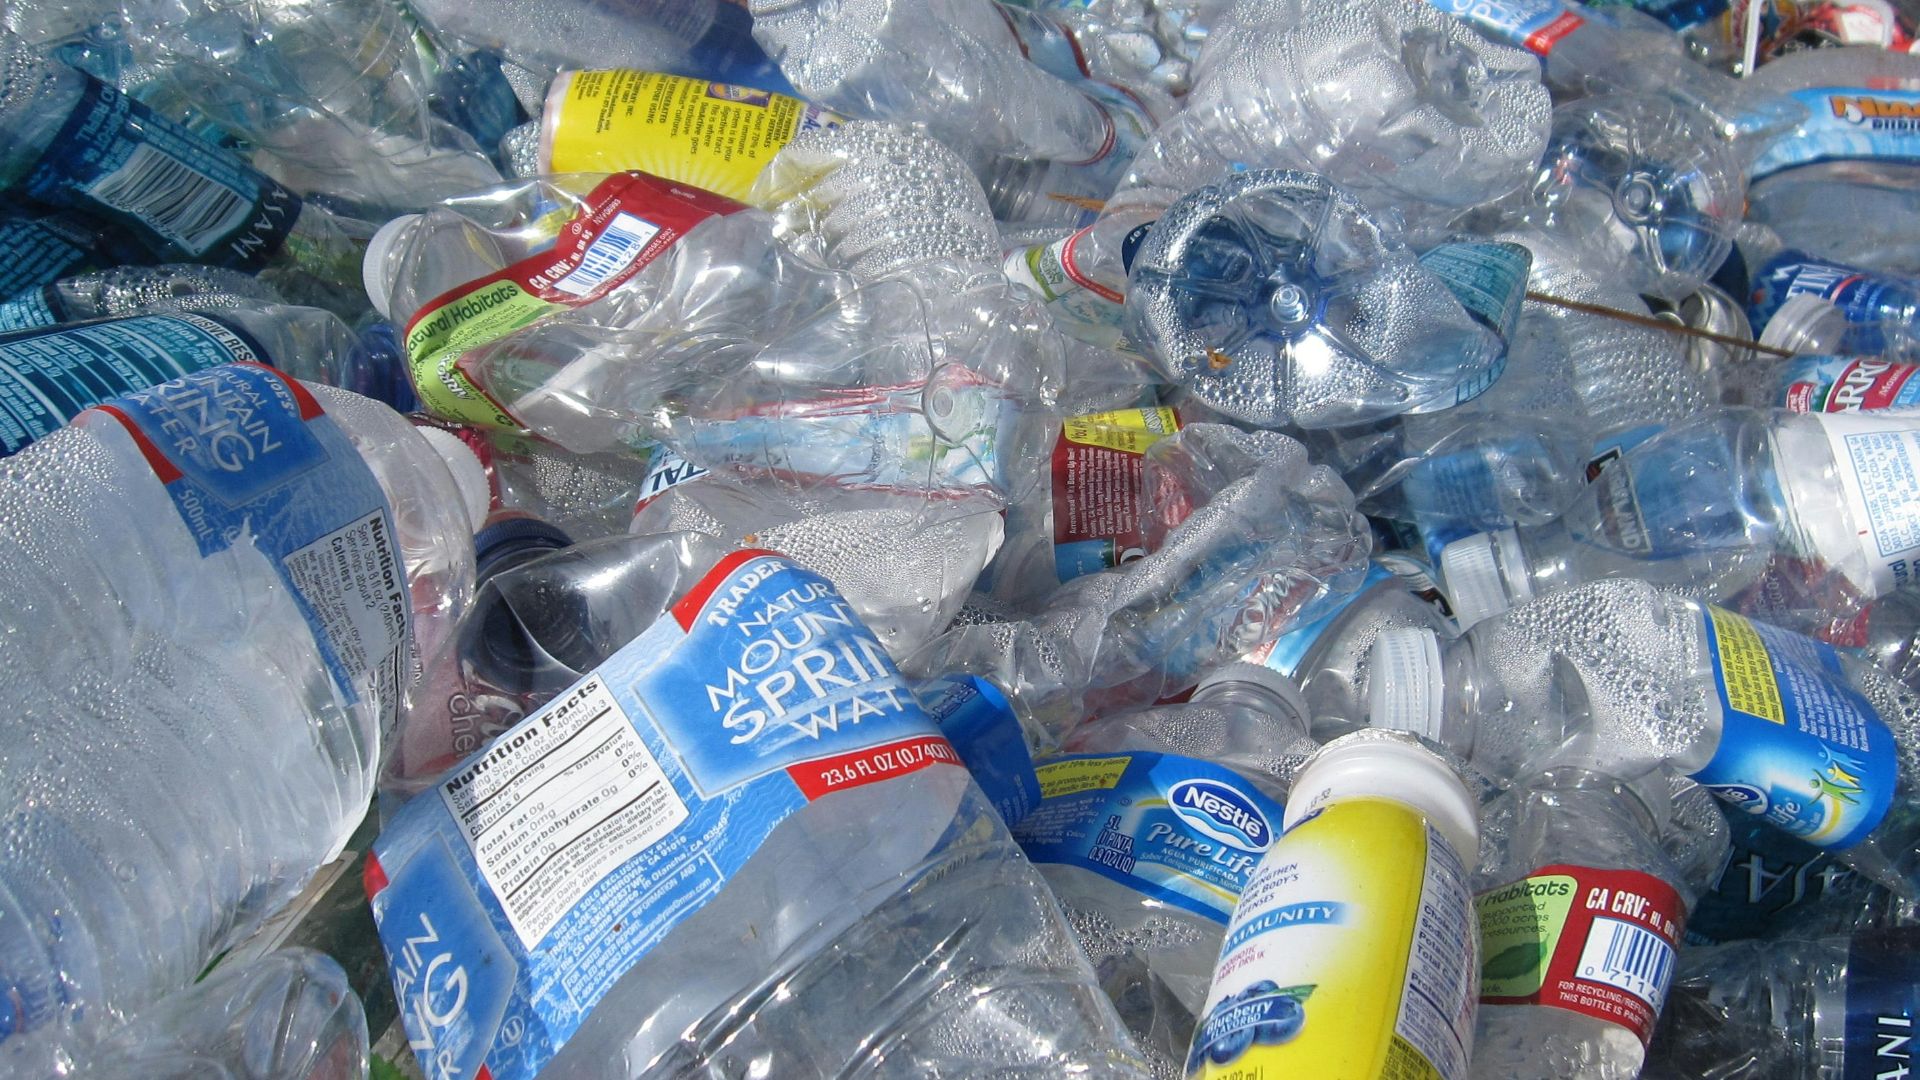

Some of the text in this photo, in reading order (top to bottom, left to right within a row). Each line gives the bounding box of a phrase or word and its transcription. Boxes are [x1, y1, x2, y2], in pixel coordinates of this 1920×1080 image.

[230, 183, 289, 261] ASANI
[529, 274, 551, 289] CA
[451, 283, 518, 325] Habitats
[131, 394, 197, 456] ATER
[158, 379, 254, 472] RING
[184, 375, 282, 454] UNTAIN
[649, 460, 707, 492] TAL
[1868, 458, 1880, 478] CCDA
[177, 490, 213, 541] 500mL
[358, 524, 370, 551] Serv.
[332, 536, 350, 582] Calories
[345, 530, 376, 609] Servings about 2
[364, 551, 375, 572] Size
[368, 572, 378, 580] 8
[370, 517, 406, 639] Nutrition Facts
[707, 560, 790, 628] TRADER
[790, 686, 904, 740] WAT
[445, 679, 599, 794] Nutrition Facts
[451, 701, 588, 804] Serving Size 8 fl oz (240mL)
[456, 698, 606, 812] Servings Per Container about 3
[614, 738, 634, 757] 0%
[621, 749, 641, 768] 0%
[628, 759, 648, 779] 0%
[821, 766, 855, 786] 23.6
[857, 759, 875, 777] FL
[875, 753, 897, 772] OZ
[463, 761, 545, 825] Amount Per Serving
[469, 792, 521, 836] Calories 0
[479, 800, 546, 855] Total Fat 0g
[494, 782, 619, 880] Total Carbohydrate 0g
[485, 808, 557, 867] Sodium 0mg
[690, 839, 703, 852] CA
[703, 815, 728, 842] 93549
[1146, 822, 1213, 856] Pure
[500, 840, 557, 893] Protein 0g
[555, 842, 623, 899] Daily are
[647, 854, 660, 865] CA
[1163, 847, 1239, 884] AGUA PURIFICADA
[579, 848, 655, 911] SOLD EXCLUSIVELY
[1262, 874, 1299, 892] BODY'S
[1485, 881, 1569, 909] Habitats
[508, 892, 524, 907] Not
[579, 862, 696, 971] WATER INFORMATION AND
[1585, 887, 1608, 910] CA
[1612, 890, 1651, 920] CRV;
[1649, 911, 1662, 931] HI,
[1422, 917, 1451, 946] Sodium
[1484, 924, 1548, 938] resources.
[1511, 914, 1549, 924] acres
[569, 945, 619, 995] BOTTLED WATER
[1416, 945, 1441, 969] Total
[1584, 966, 1595, 977] 0
[1411, 972, 1445, 1007] Protein
[1558, 980, 1574, 991] FOR
[1207, 1001, 1274, 1034] Blueberry
[1211, 1013, 1261, 1039] FLAVORED
[1559, 992, 1643, 1025] THIS BOTTLE IS PART
[1876, 1016, 1912, 1080] ANI
